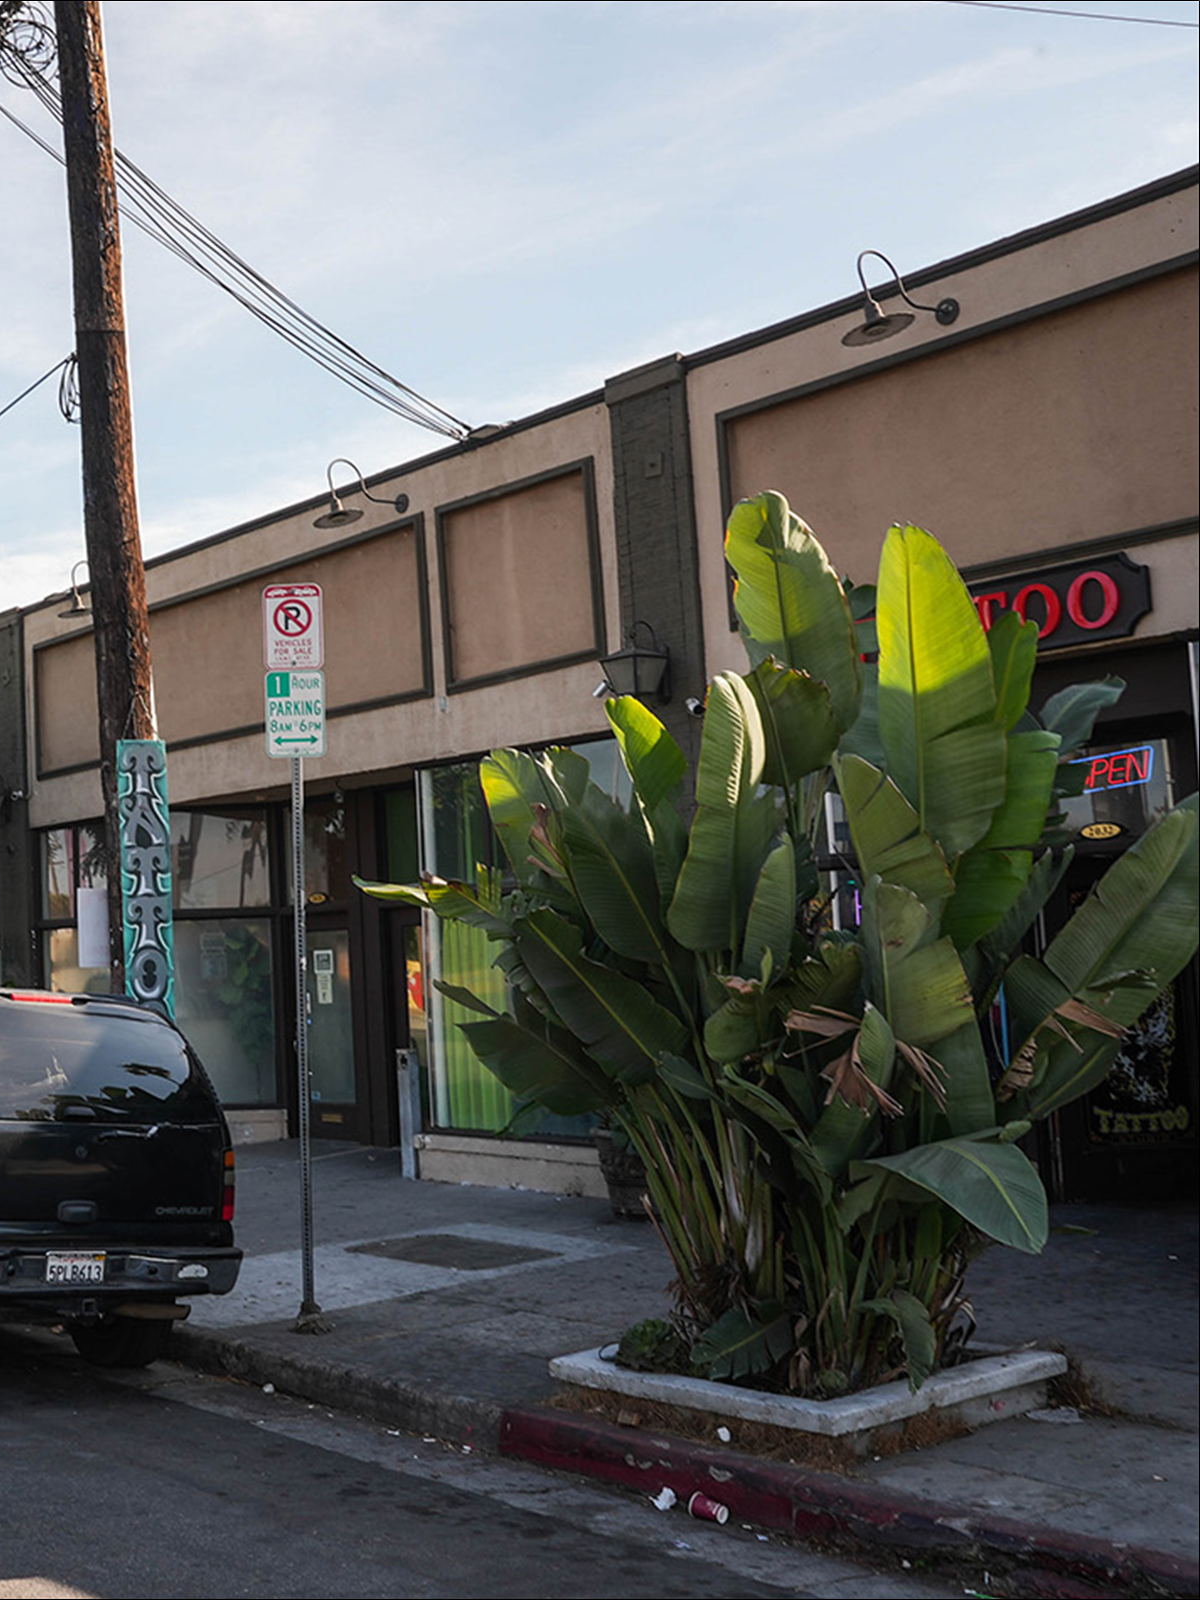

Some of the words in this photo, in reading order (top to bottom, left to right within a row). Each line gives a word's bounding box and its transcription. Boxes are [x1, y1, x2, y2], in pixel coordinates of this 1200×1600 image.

[274, 638, 312, 647] VEHICLES
[274, 648, 290, 656] FOR
[293, 647, 312, 655] SALE
[275, 676, 282, 694] 1
[291, 678, 320, 690] HOUR
[269, 700, 321, 717] PARKING
[270, 719, 293, 733] 8AM
[299, 719, 321, 733] 6PM
[1085, 750, 1149, 788] PEN
[117, 744, 173, 1015] TATTO
[1092, 1105, 1189, 1133] TATTOO
[154, 1206, 215, 1217] CHEVROLET
[49, 1265, 102, 1283] 5PLB613
